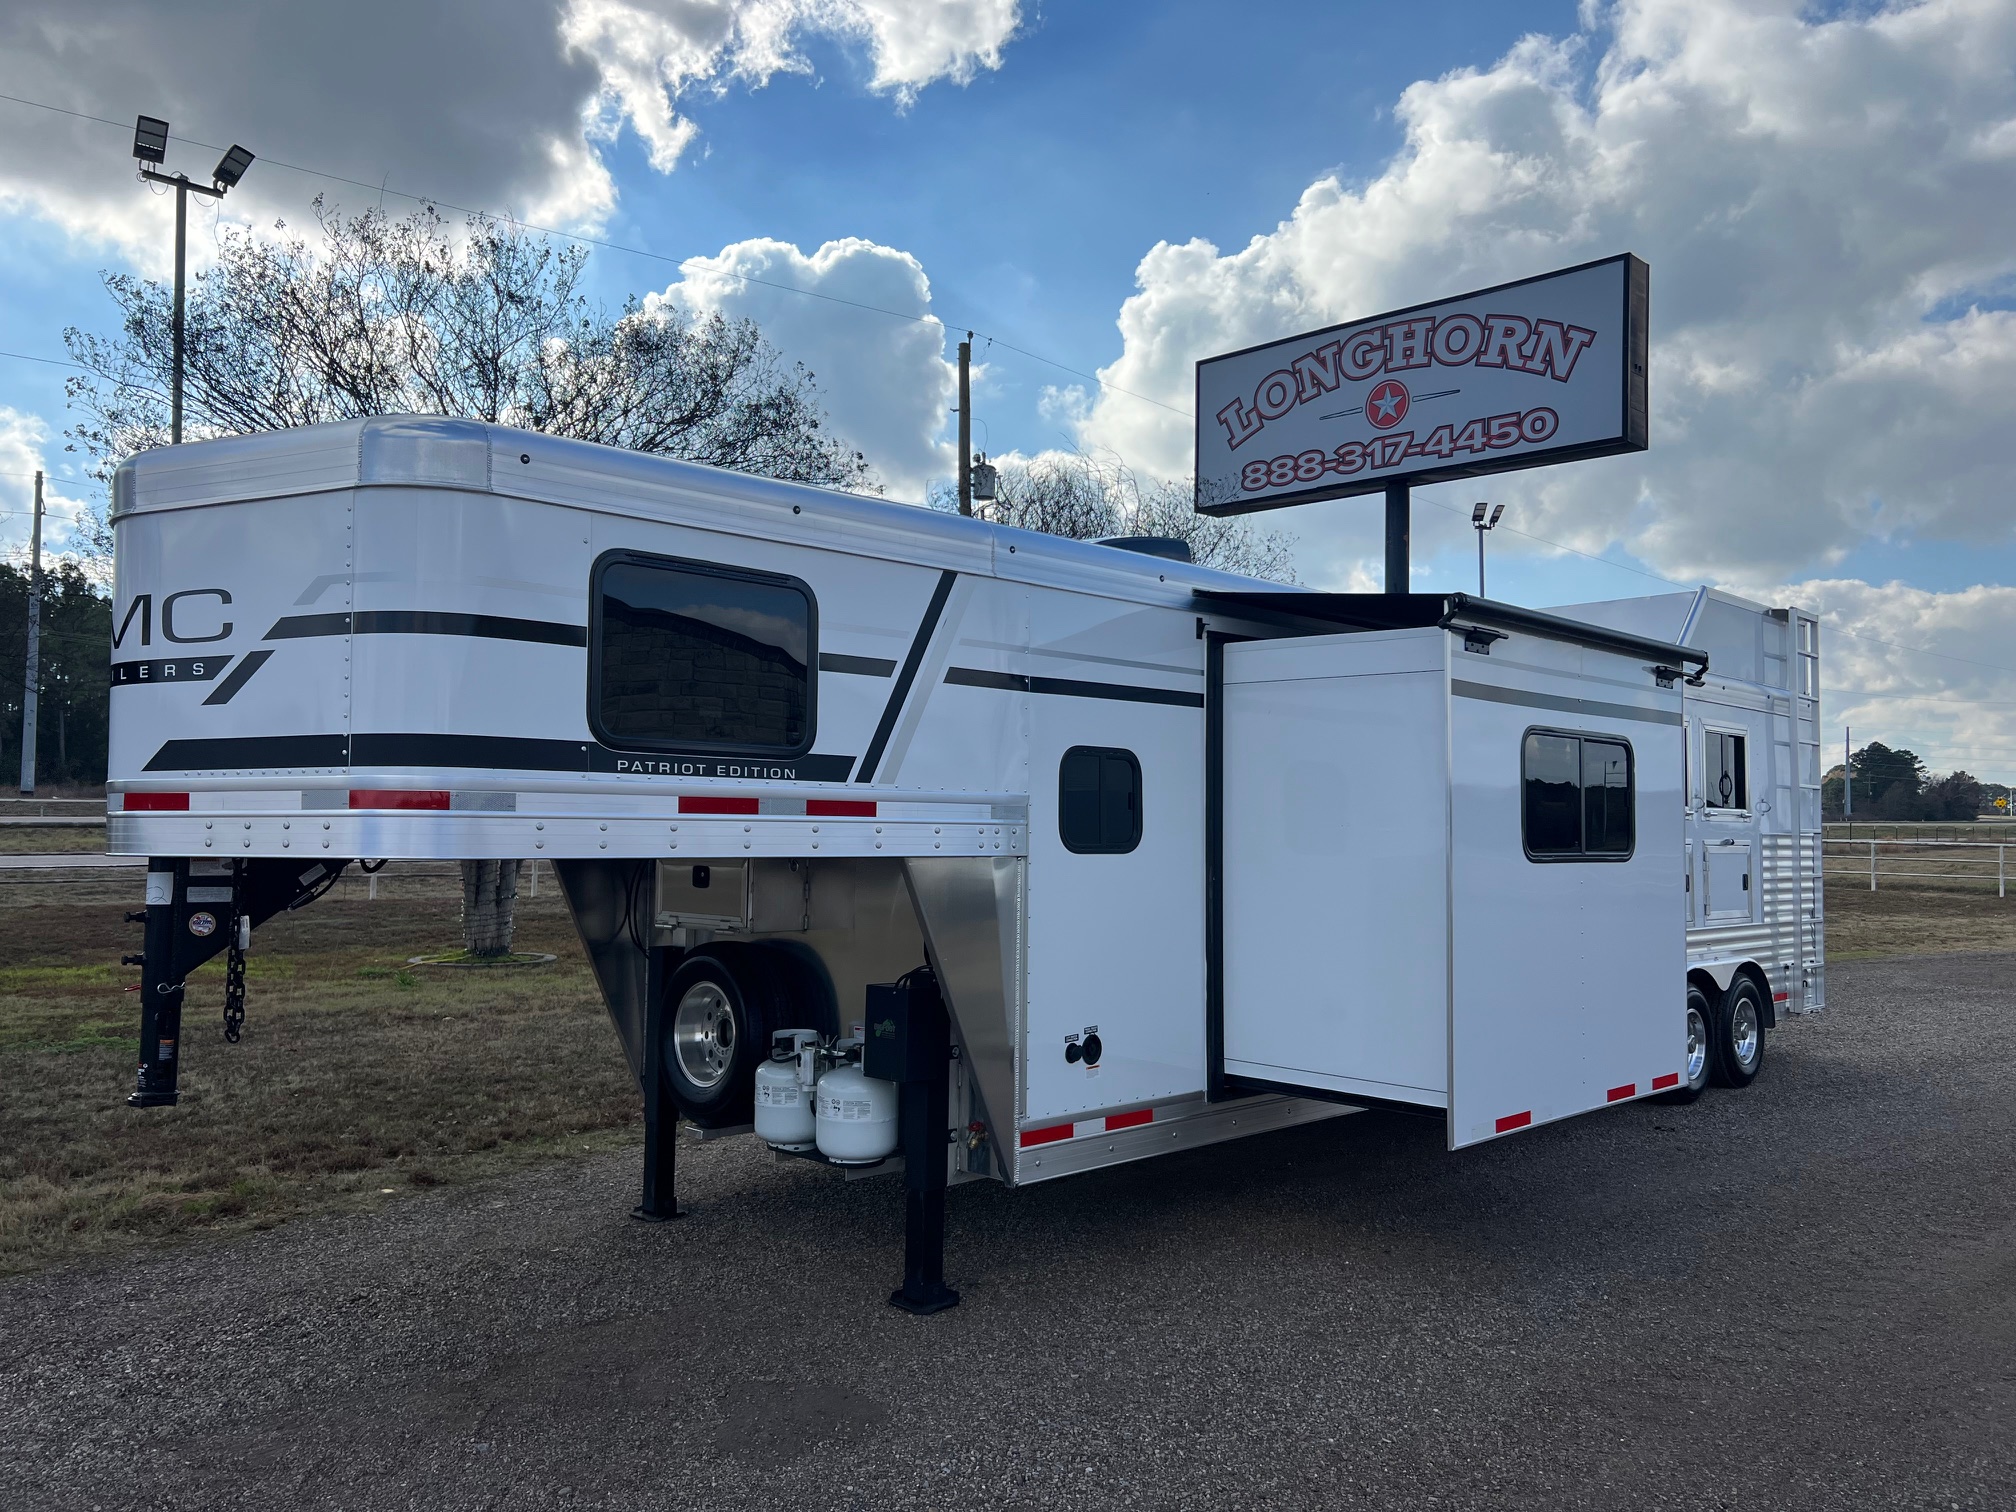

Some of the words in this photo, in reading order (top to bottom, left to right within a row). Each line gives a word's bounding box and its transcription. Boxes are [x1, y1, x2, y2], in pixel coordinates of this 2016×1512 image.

[1216, 314, 1597, 450] LONGHORN
[1241, 407, 1559, 491] 888-317-4450
[617, 760, 706, 775] PATRIOT
[717, 765, 796, 779] EDITION
